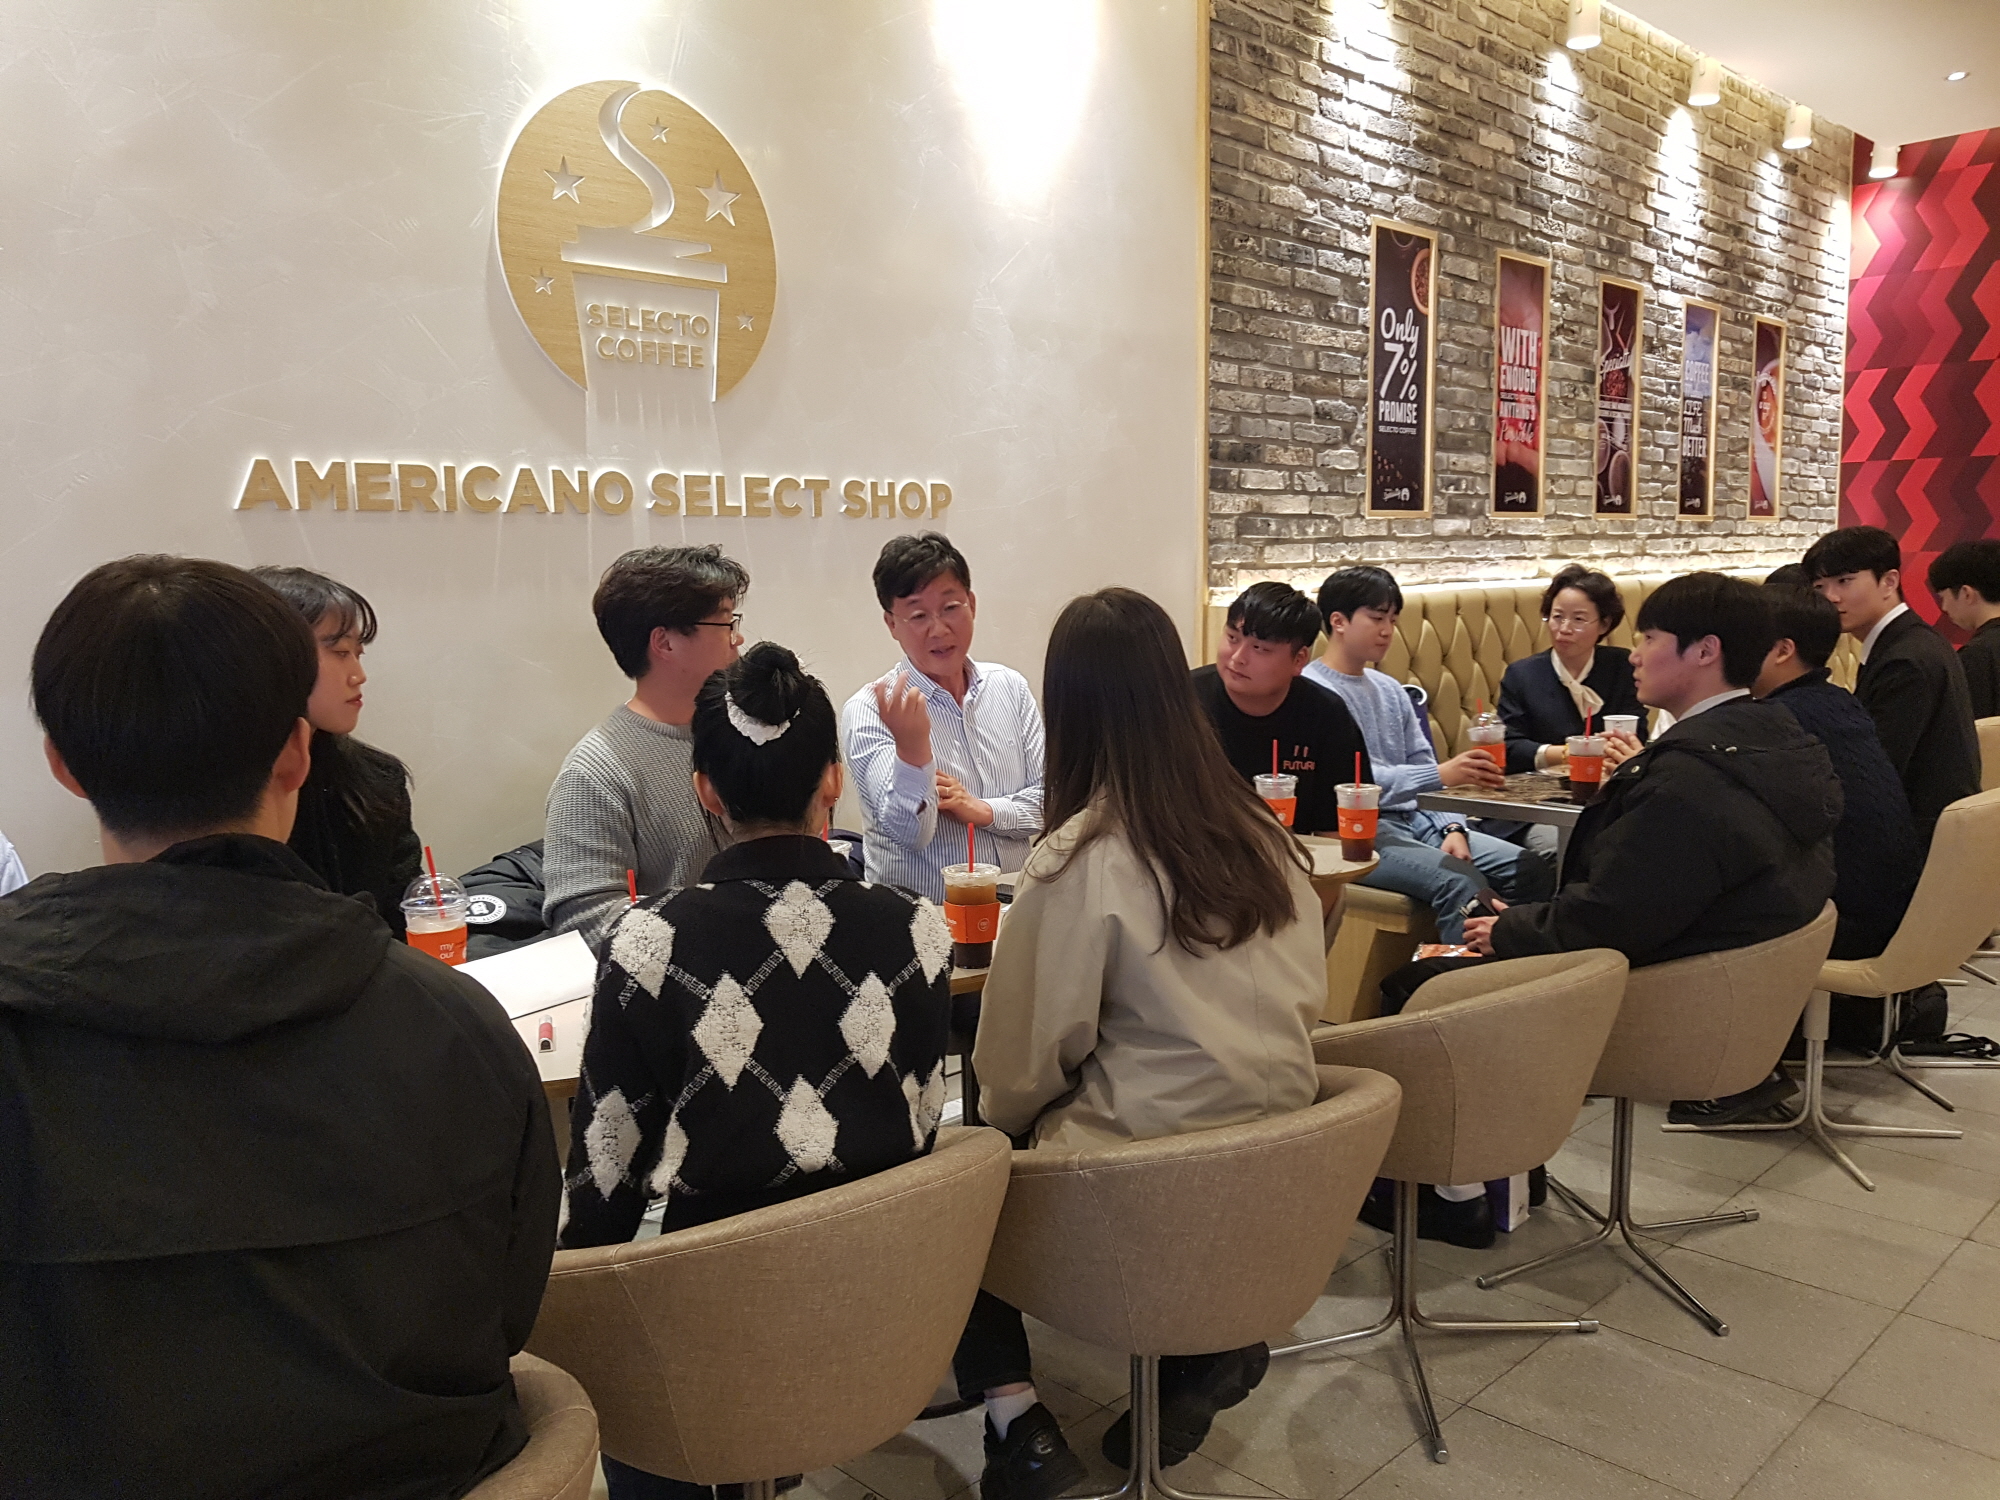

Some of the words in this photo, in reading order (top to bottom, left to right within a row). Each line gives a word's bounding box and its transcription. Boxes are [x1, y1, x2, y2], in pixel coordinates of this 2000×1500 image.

[586, 303, 710, 338] SELECTO
[1381, 307, 1419, 359] Only
[596, 335, 704, 368] COFFEE
[1500, 325, 1538, 368] WITH
[1380, 342, 1418, 401] 7%
[1500, 365, 1537, 393] ENOUGH
[1379, 400, 1418, 424] PROMISE
[234, 458, 634, 516] AMERICANO
[647, 471, 831, 518] SELECT
[840, 478, 953, 519] SHOP
[440, 943, 454, 951] my
[440, 951, 454, 960] our
